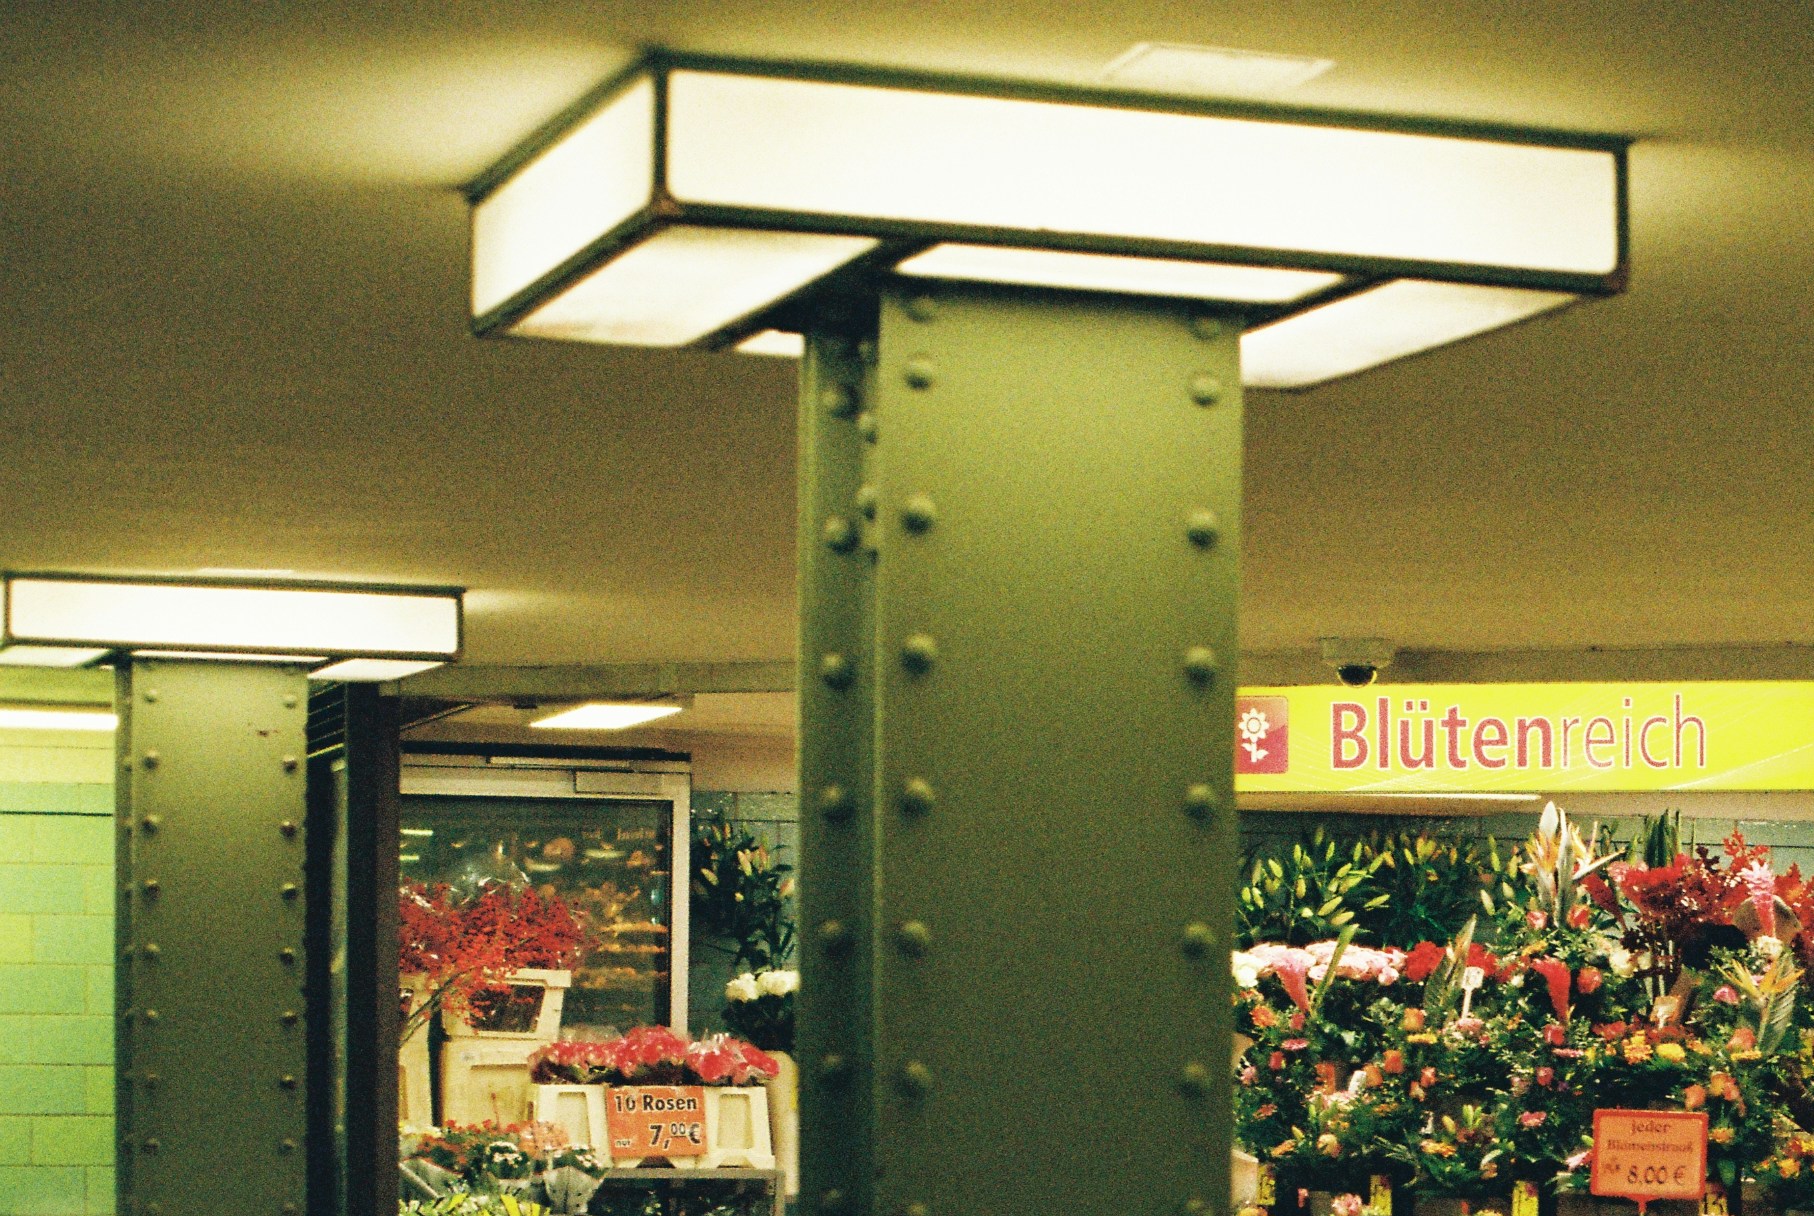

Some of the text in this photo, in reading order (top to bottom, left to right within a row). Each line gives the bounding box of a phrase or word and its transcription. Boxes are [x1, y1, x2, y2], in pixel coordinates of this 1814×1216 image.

[1332, 695, 1706, 768] Blütenreich
[615, 1095, 698, 1112] 10 Rosen
